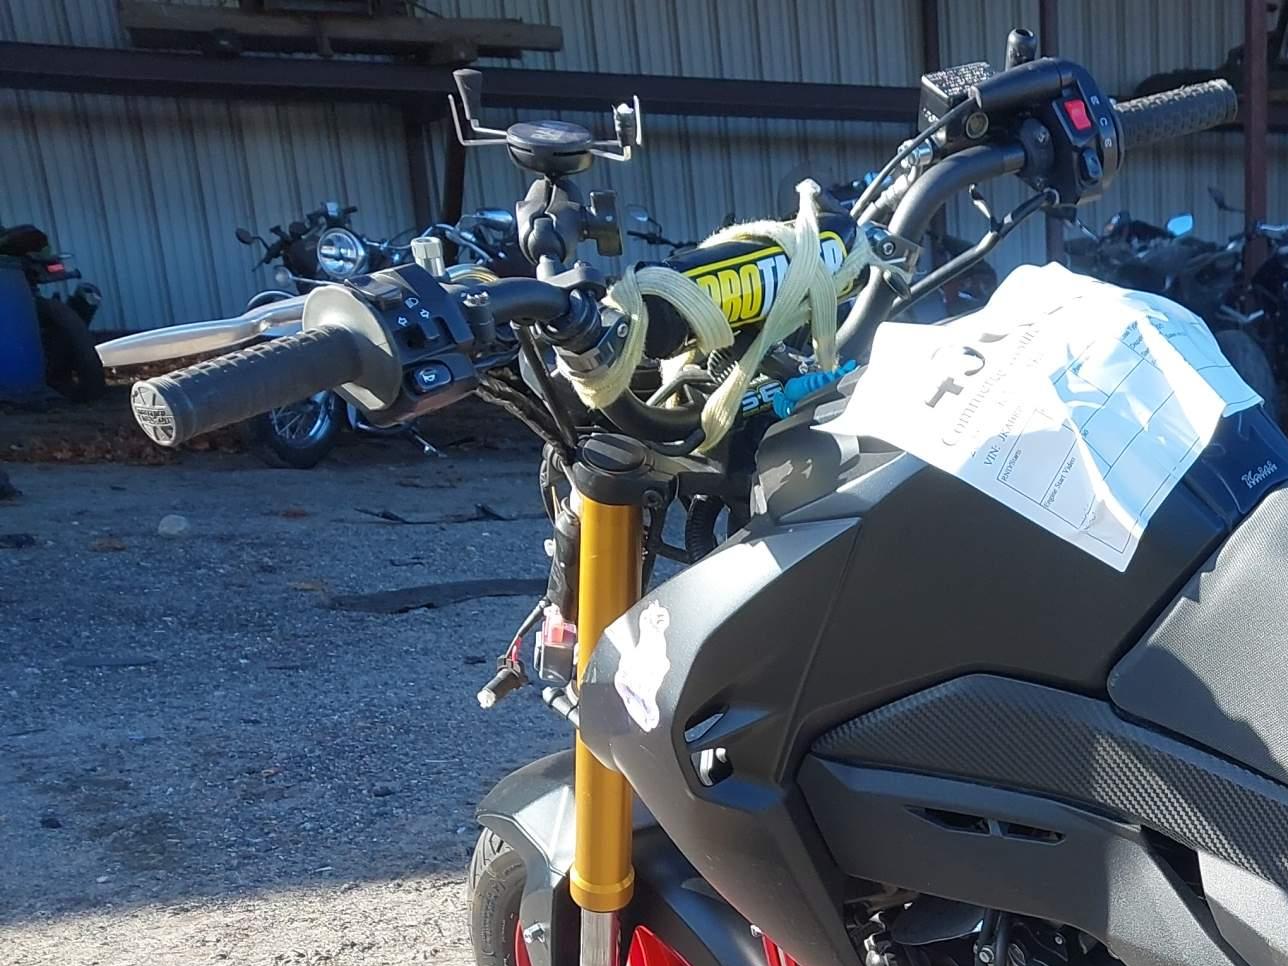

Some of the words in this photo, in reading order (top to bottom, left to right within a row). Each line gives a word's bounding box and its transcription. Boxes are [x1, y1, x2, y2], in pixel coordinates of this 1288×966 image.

[984, 444, 1001, 466] VIN:
[1043, 488, 1058, 508] Engine
[1054, 474, 1066, 488] Start
